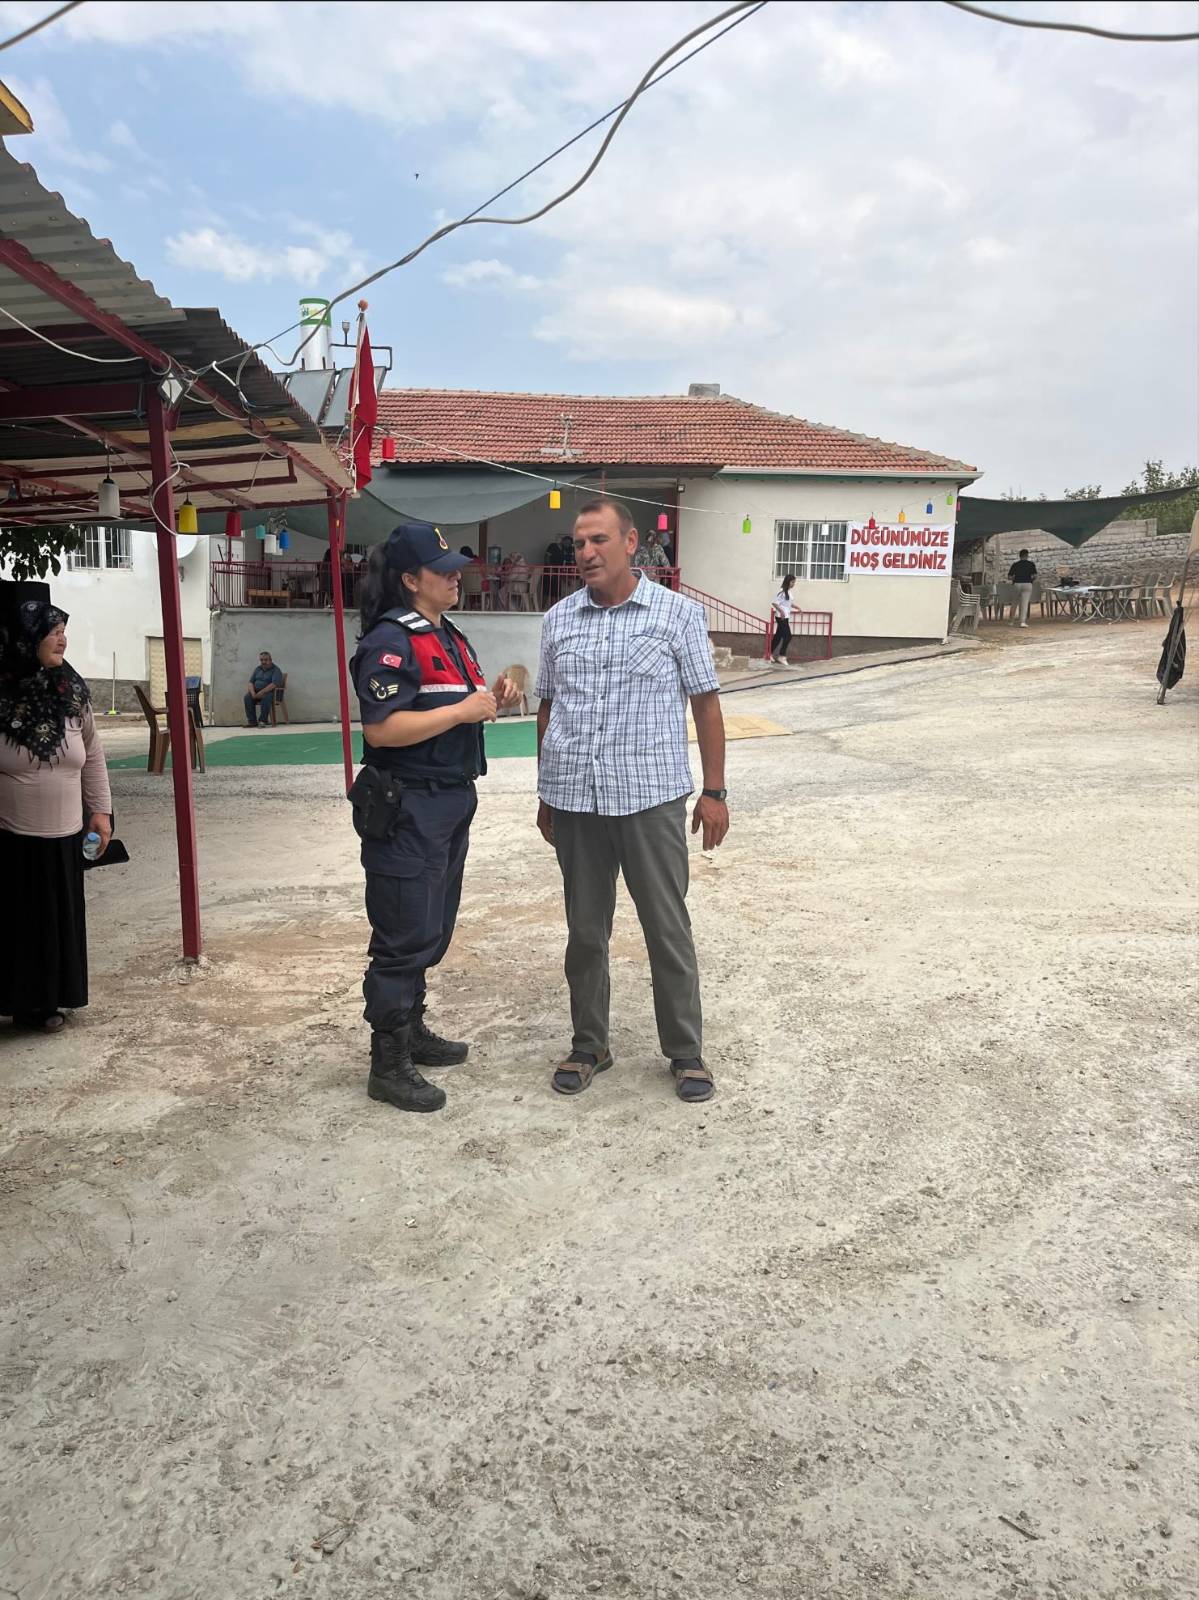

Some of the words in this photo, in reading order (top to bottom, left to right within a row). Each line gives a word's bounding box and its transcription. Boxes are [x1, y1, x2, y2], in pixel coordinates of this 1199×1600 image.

[851, 526, 949, 547] DÜĞÜNÜMÜZE
[850, 552, 879, 571] HOŞ
[882, 550, 946, 570] GELDİNİZ
